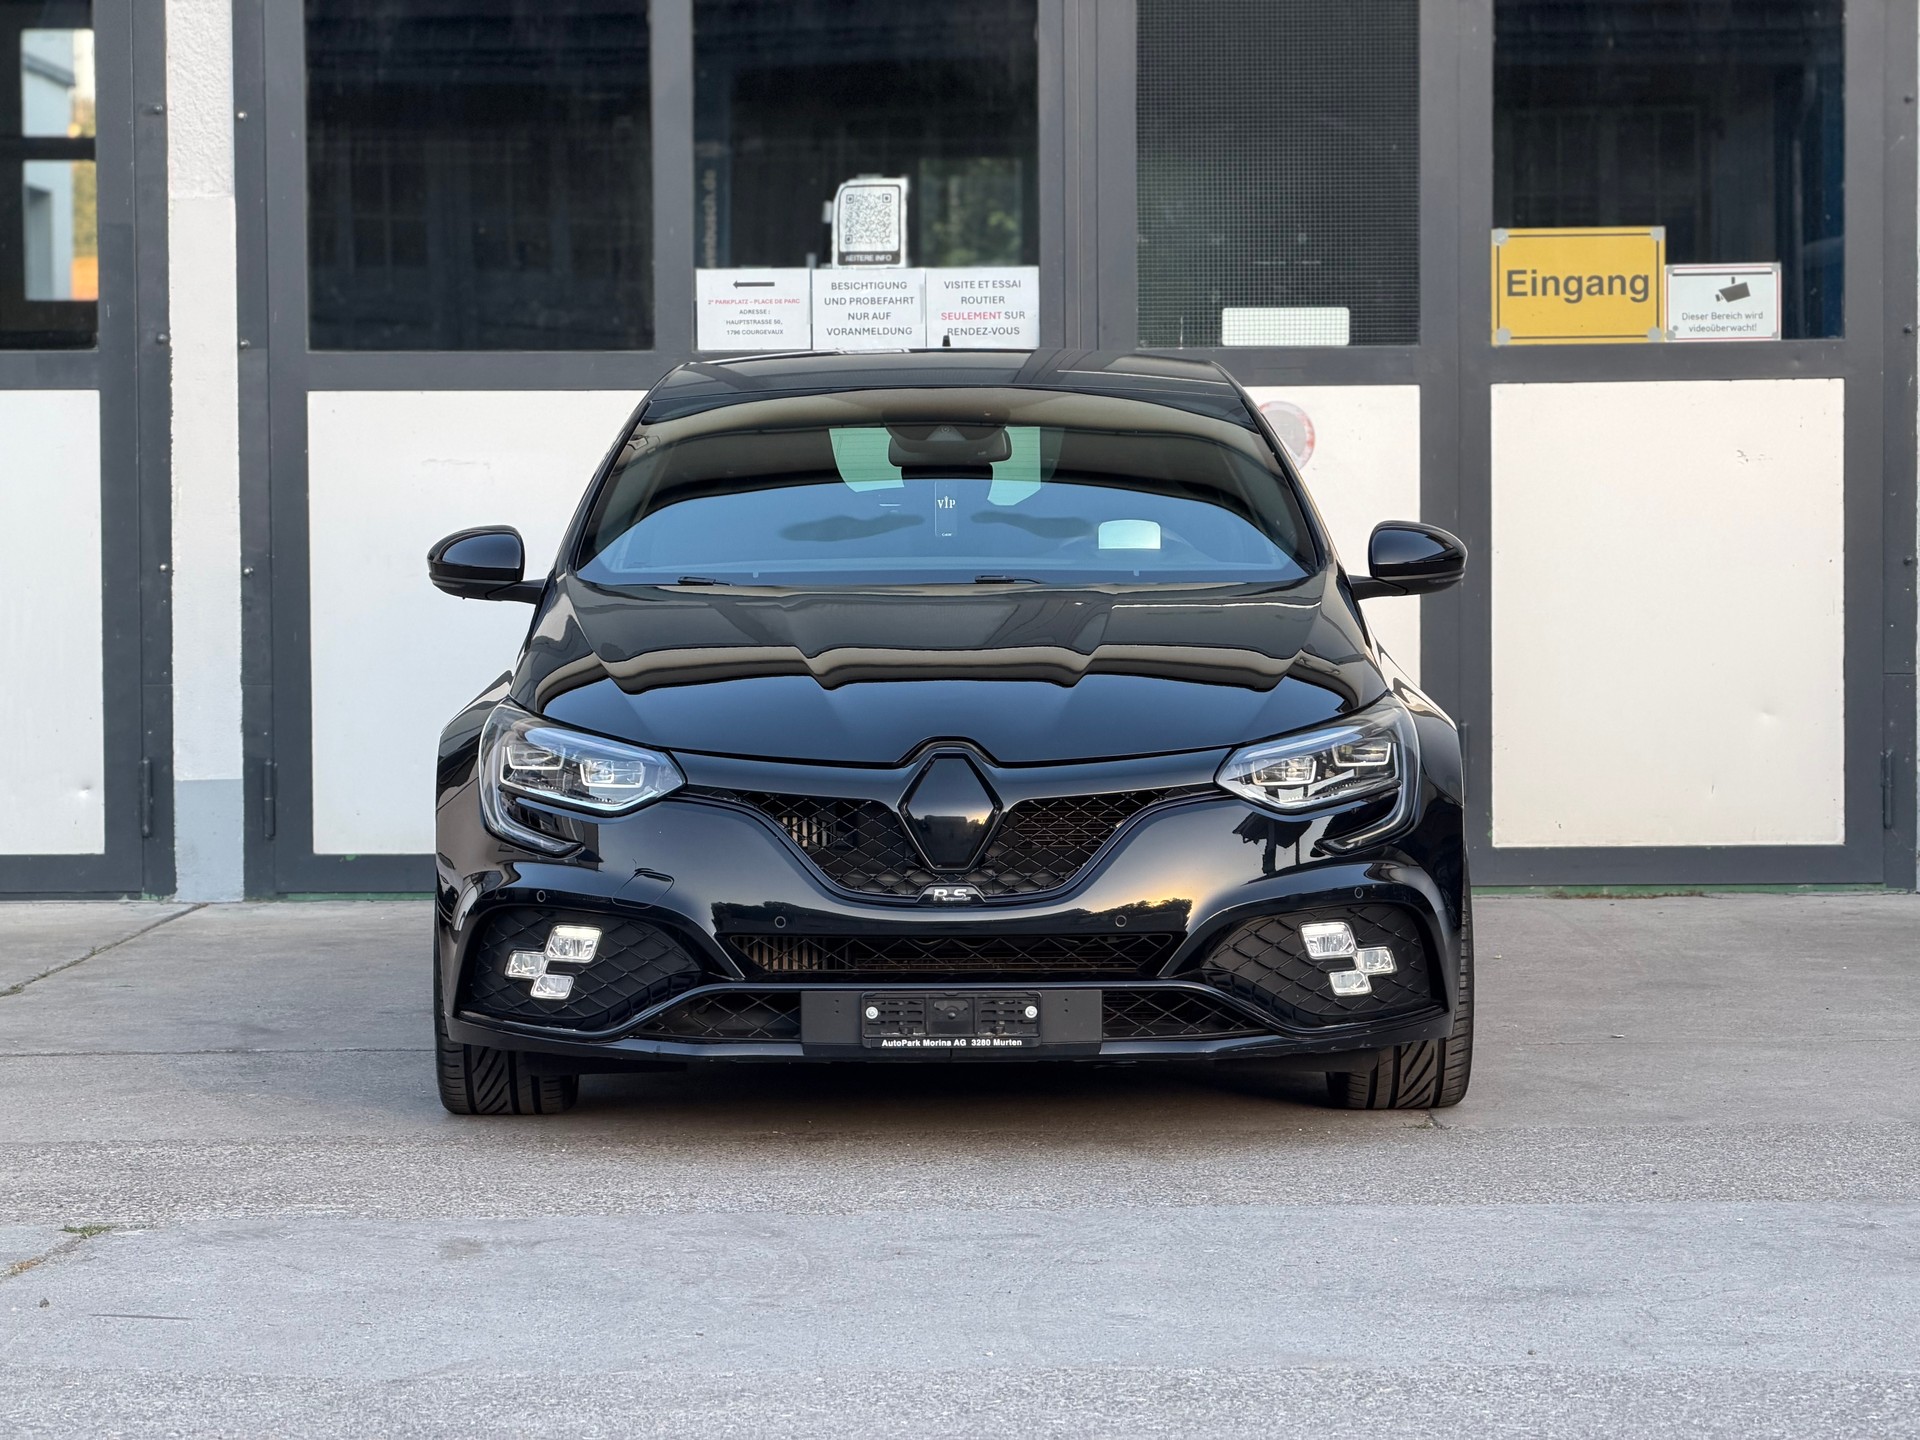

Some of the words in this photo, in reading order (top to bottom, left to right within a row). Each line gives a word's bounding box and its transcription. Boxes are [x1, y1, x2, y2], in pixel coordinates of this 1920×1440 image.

[831, 281, 907, 290] BESICHTIGUNG
[944, 280, 976, 289] VISITE
[978, 280, 990, 289] ET
[992, 279, 1022, 288] ESSAI
[1506, 269, 1650, 304] Eingang
[824, 297, 847, 306] UND
[849, 296, 915, 306] PROBEFAHRT
[961, 296, 1005, 304] ROUTIER
[848, 312, 870, 321] NUR
[871, 311, 891, 321] AUF
[941, 312, 1002, 321] SEULEMENT
[1004, 311, 1026, 320] SUR
[1681, 312, 1709, 321] Dieser
[1711, 311, 1743, 320] Bereich
[1744, 311, 1764, 320] wird
[827, 326, 913, 336] VORANMELDUNG
[947, 326, 1020, 336] RENDEZ-VOUS
[1688, 323, 1757, 333] videoüberwacht!
[937, 496, 956, 509] VIP
[881, 1039, 921, 1047] AutoPark
[922, 1039, 952, 1047] Morina
[953, 1039, 967, 1047] AG
[971, 1039, 991, 1047] 3280
[993, 1039, 1023, 1047] Murten
